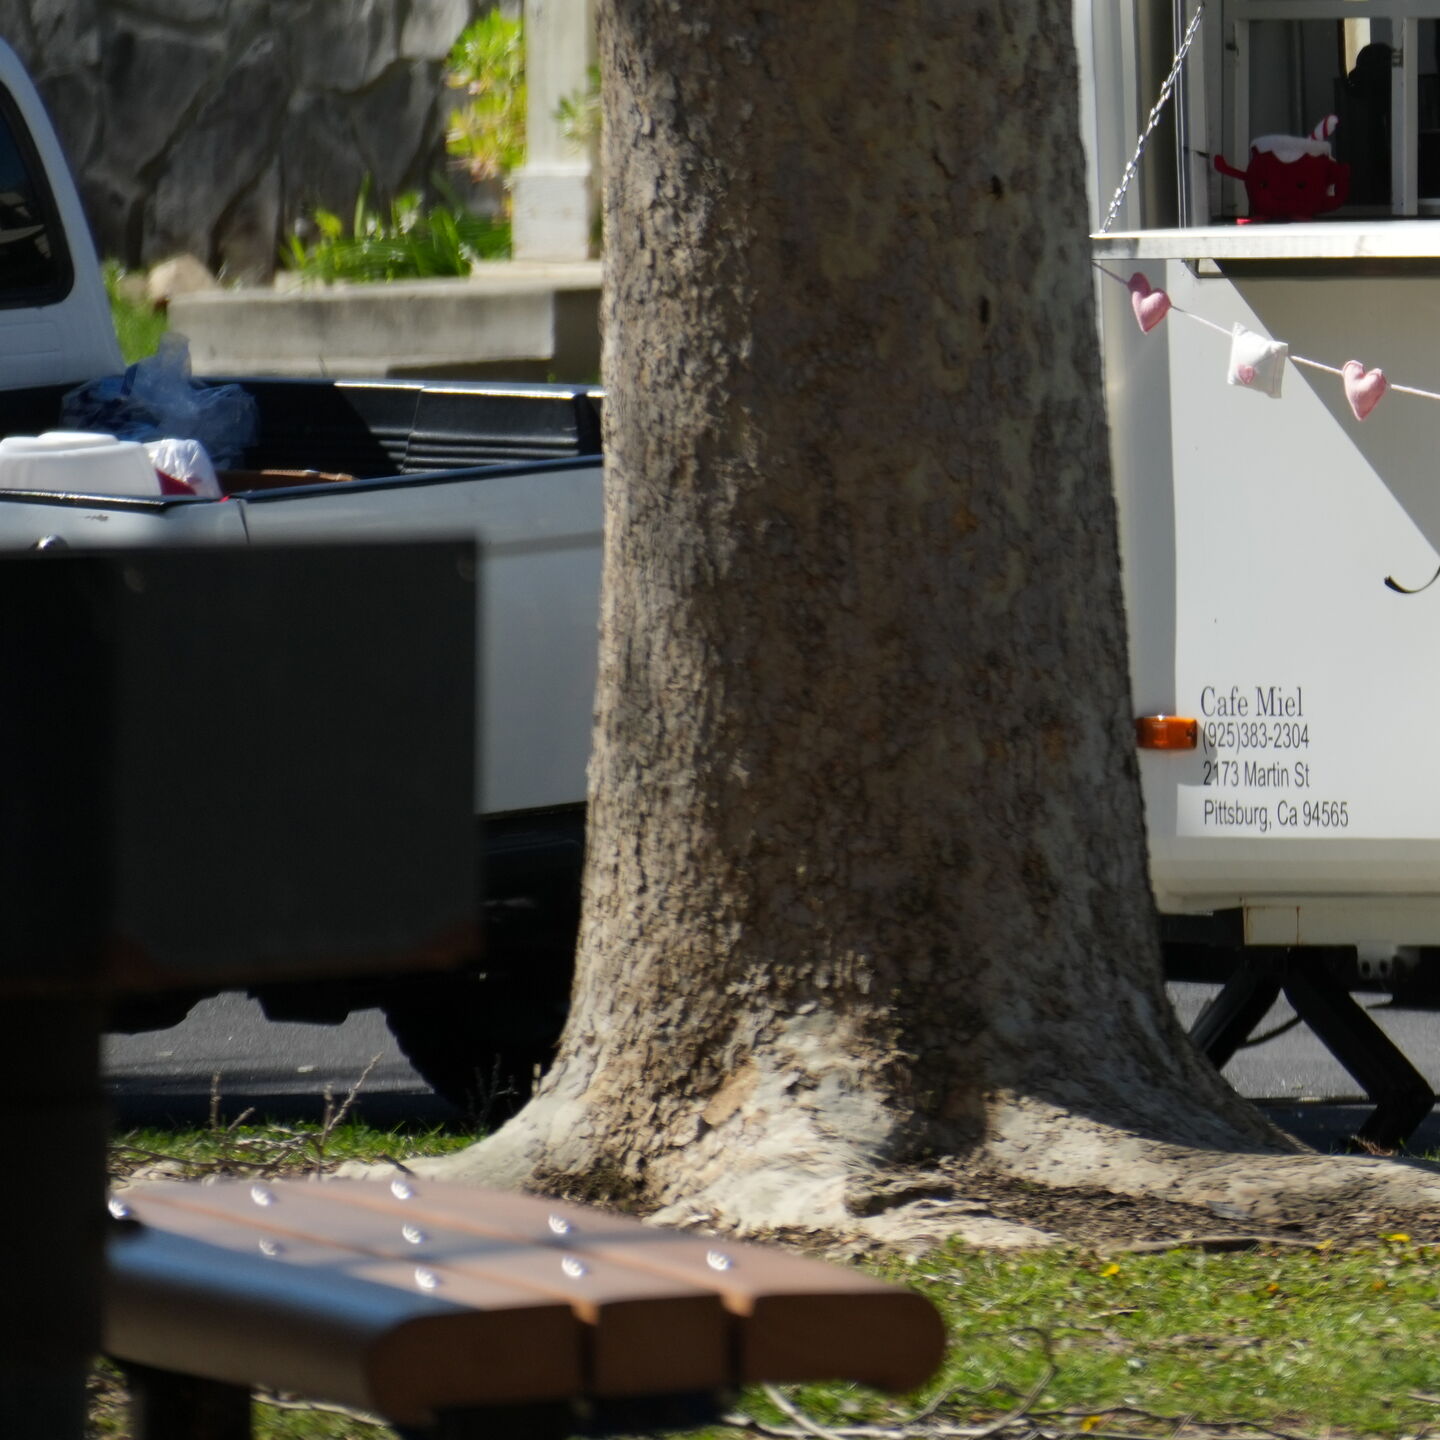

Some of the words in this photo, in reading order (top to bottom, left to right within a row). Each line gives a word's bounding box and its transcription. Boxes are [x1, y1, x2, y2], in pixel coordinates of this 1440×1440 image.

[1200, 686, 1249, 717] Cafe
[1255, 686, 1304, 717] Miel
[1202, 721, 1310, 754] (925)383-2304
[1203, 760, 1239, 786] 2173
[1244, 761, 1290, 787] Martin
[1294, 761, 1311, 788] St
[1204, 799, 1272, 832] Pittsburg,
[1277, 800, 1298, 826] Ca
[1302, 800, 1349, 827] 94565
